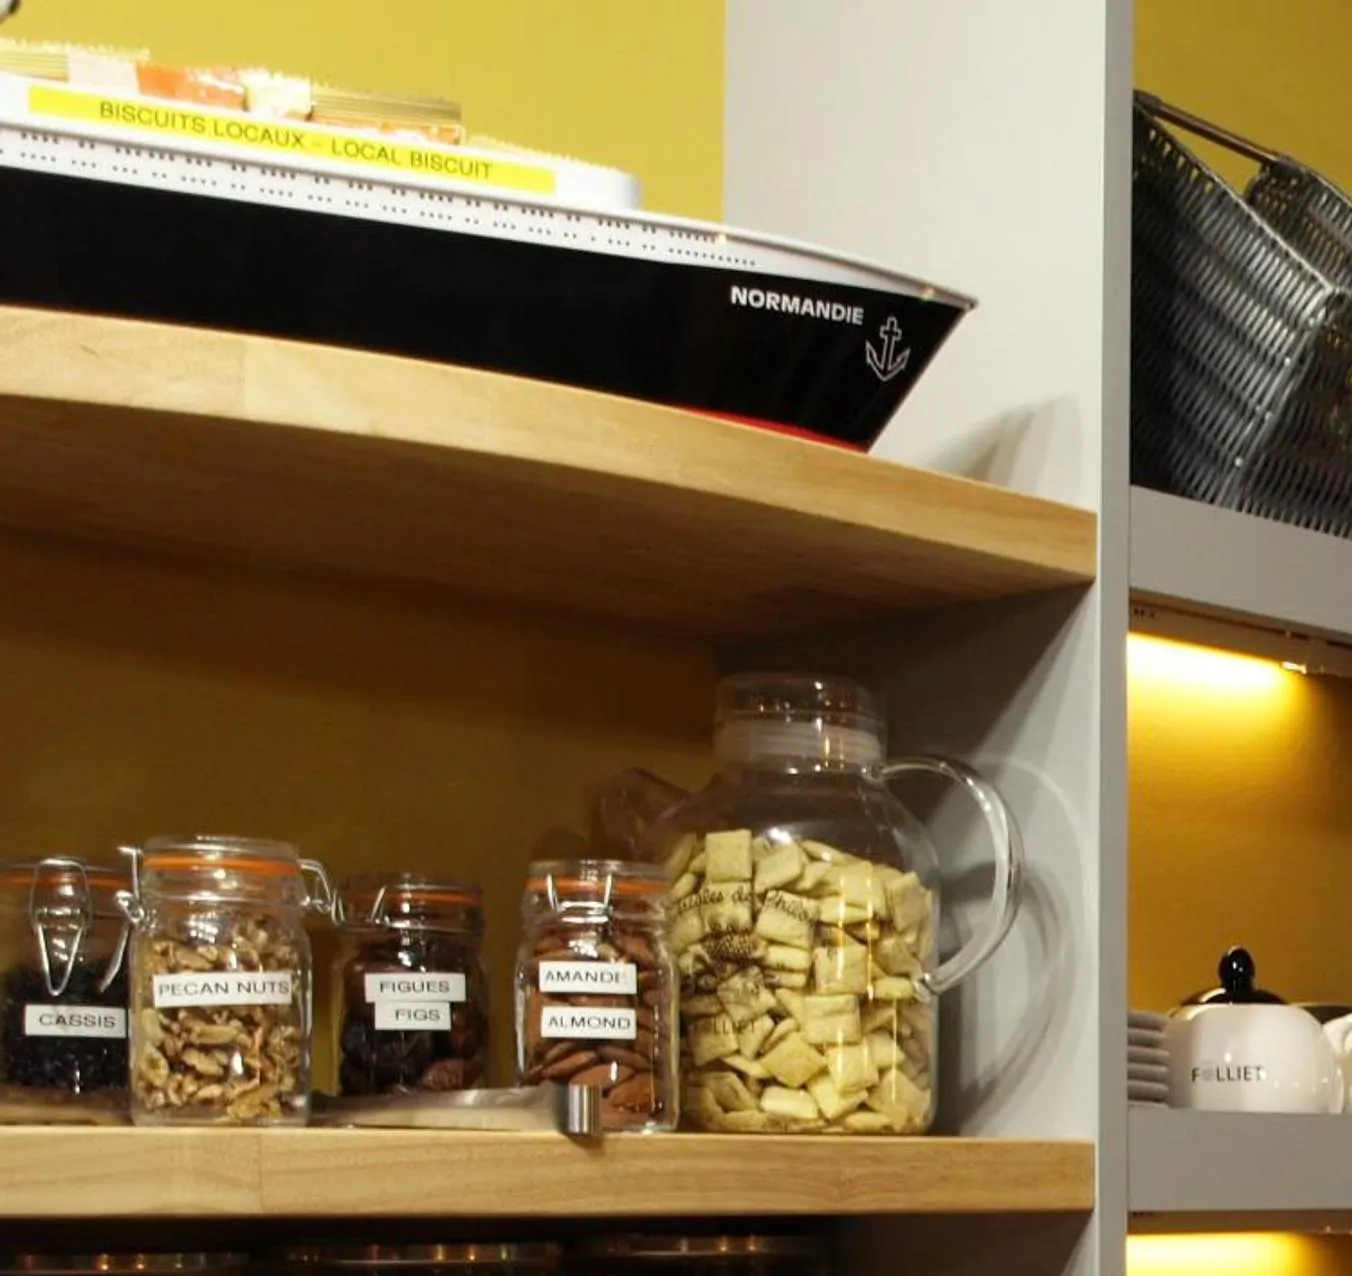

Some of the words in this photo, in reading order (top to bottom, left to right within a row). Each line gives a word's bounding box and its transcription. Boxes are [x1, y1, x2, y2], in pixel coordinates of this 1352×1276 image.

[100, 100, 206, 134] BISCUITS
[213, 114, 305, 149] LOCAUX
[331, 138, 403, 167] LOCAL
[409, 145, 493, 179] BISCUIT
[730, 285, 865, 325] NORMANDIE
[158, 981, 230, 998] PECAN
[237, 980, 290, 995] NUTS
[380, 980, 451, 994] FIGUES
[39, 1013, 117, 1029] CASSIS
[395, 1008, 440, 1022] FIGS
[548, 1015, 631, 1030] ALMOND
